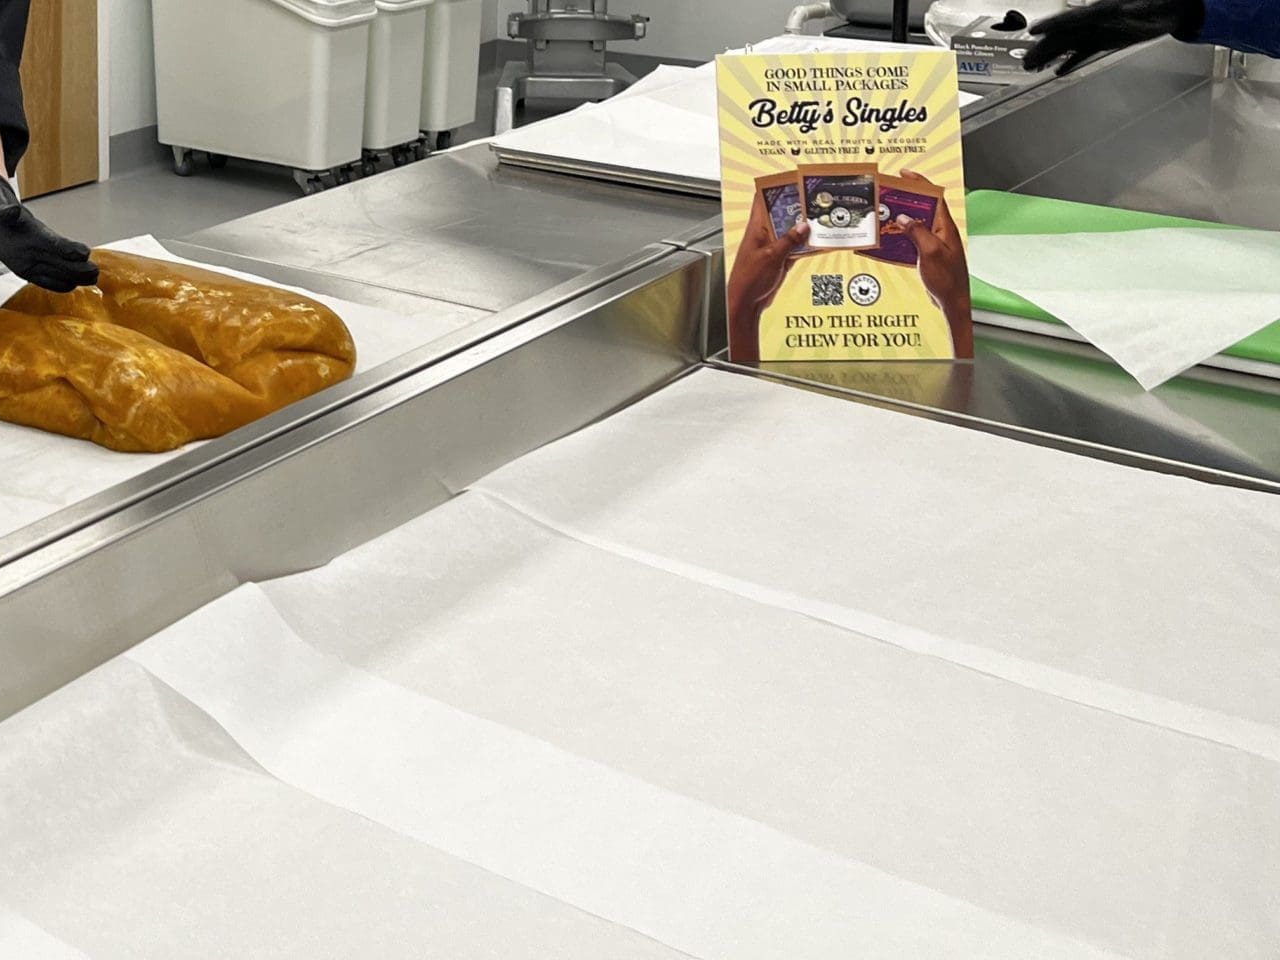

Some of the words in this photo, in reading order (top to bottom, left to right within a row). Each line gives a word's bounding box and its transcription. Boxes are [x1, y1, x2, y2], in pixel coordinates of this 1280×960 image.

[765, 68, 806, 80] GOOD
[810, 67, 862, 79] THINGS
[867, 66, 909, 78] COME
[766, 81, 781, 92] IN
[785, 80, 831, 92] SMALL
[835, 79, 909, 91] PACKAGES
[748, 98, 834, 134] Betty's
[842, 97, 927, 132] Singles
[804, 147, 837, 155] GLUTEN
[838, 147, 860, 155] FREE
[879, 146, 902, 154] DAIRY
[904, 145, 927, 153] FREE
[785, 315, 823, 329] FIND
[827, 315, 862, 328] THE
[867, 314, 919, 328] RIGHT
[785, 334, 839, 348] CHEW
[843, 333, 879, 347] FOR
[881, 333, 922, 347] YOU!
